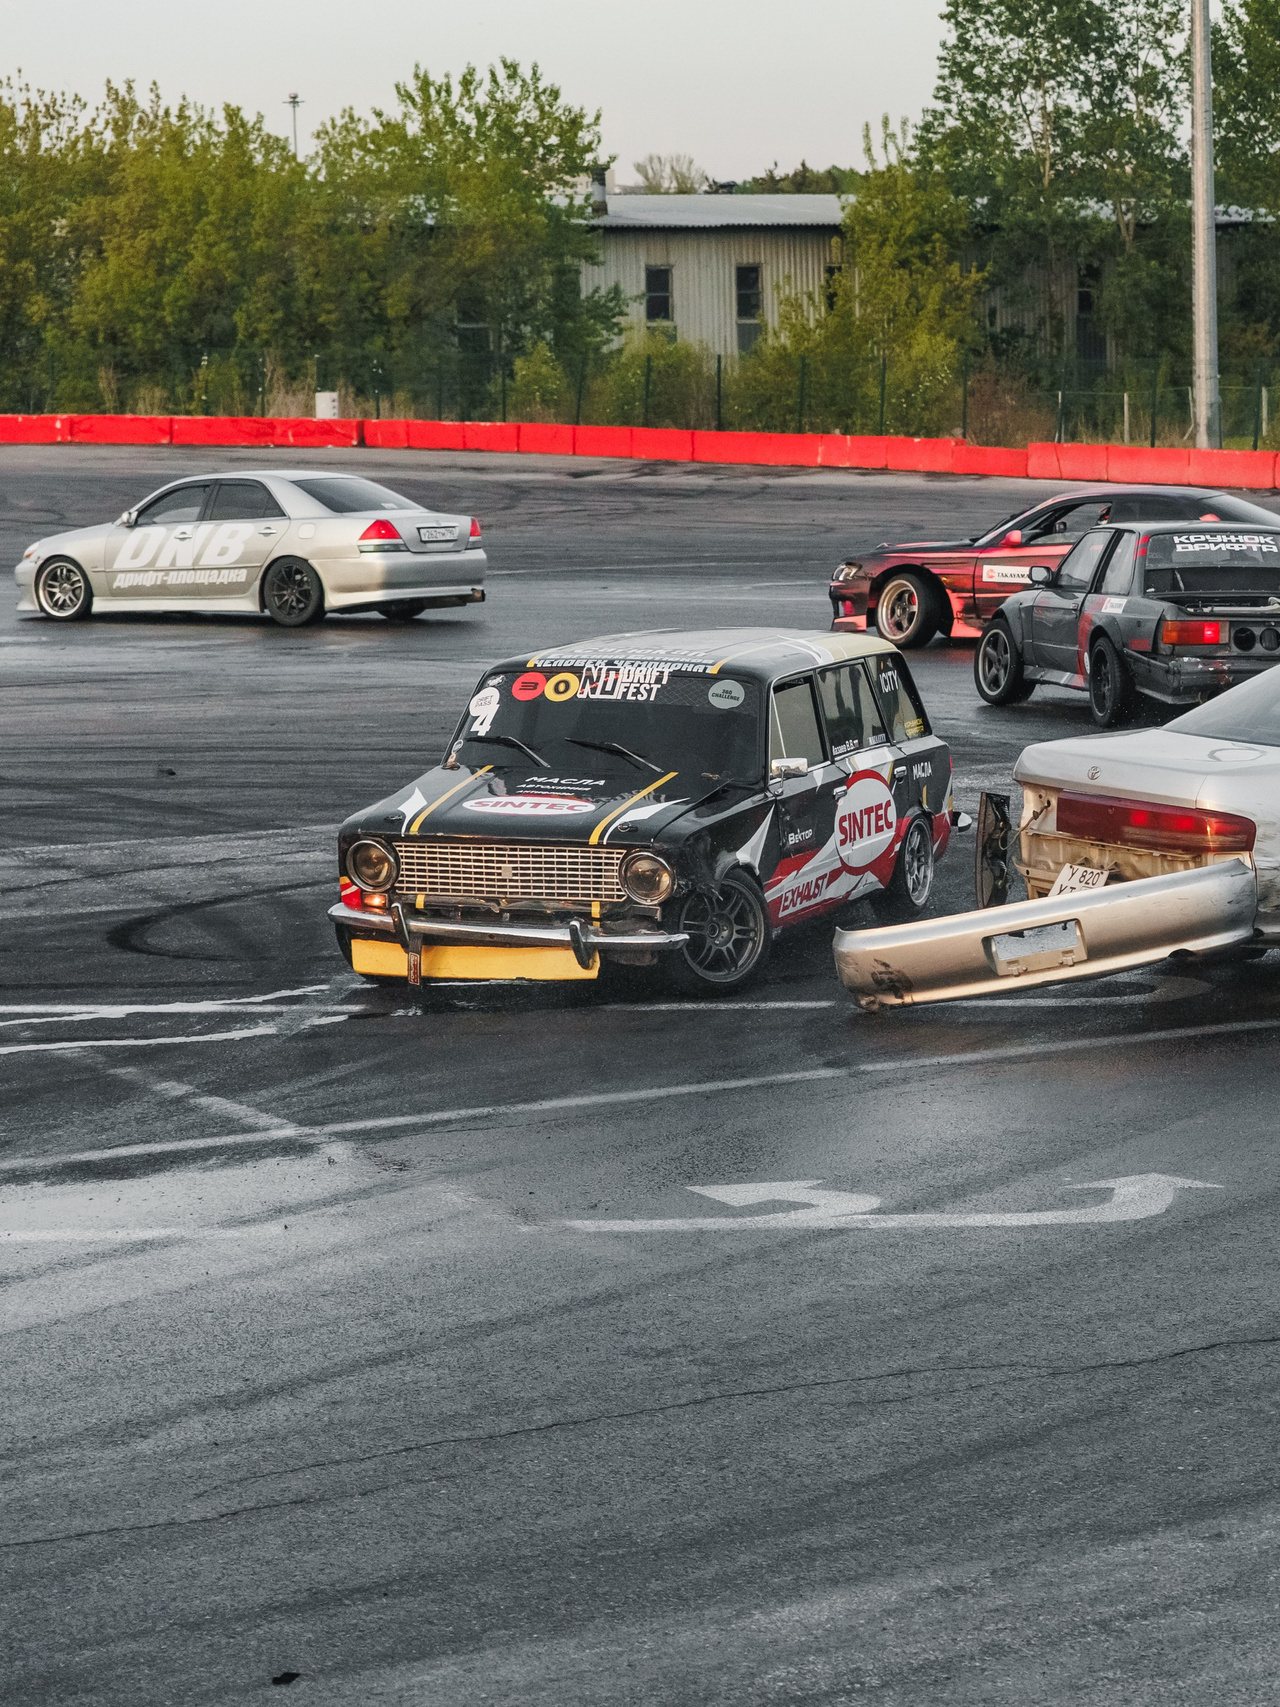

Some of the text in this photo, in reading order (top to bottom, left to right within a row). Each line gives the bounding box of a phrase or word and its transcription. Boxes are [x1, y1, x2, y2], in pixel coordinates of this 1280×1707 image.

[113, 523, 254, 568] DNB
[1173, 534, 1276, 544] КРУЖОК
[1175, 543, 1279, 553] ДРИФТА
[112, 568, 248, 589] дрифт-площадка
[535, 659, 608, 668] ЧЕЛОВЕК
[617, 682, 662, 701] FEST
[711, 692, 740, 702] CHALLENGE
[912, 761, 933, 780] МАСЛА
[525, 776, 606, 786] МАСЛА
[469, 800, 588, 812] SINTEC
[838, 799, 894, 847] SINTEC
[1078, 869, 1100, 886] 820
[780, 872, 828, 913] EXHAUST
